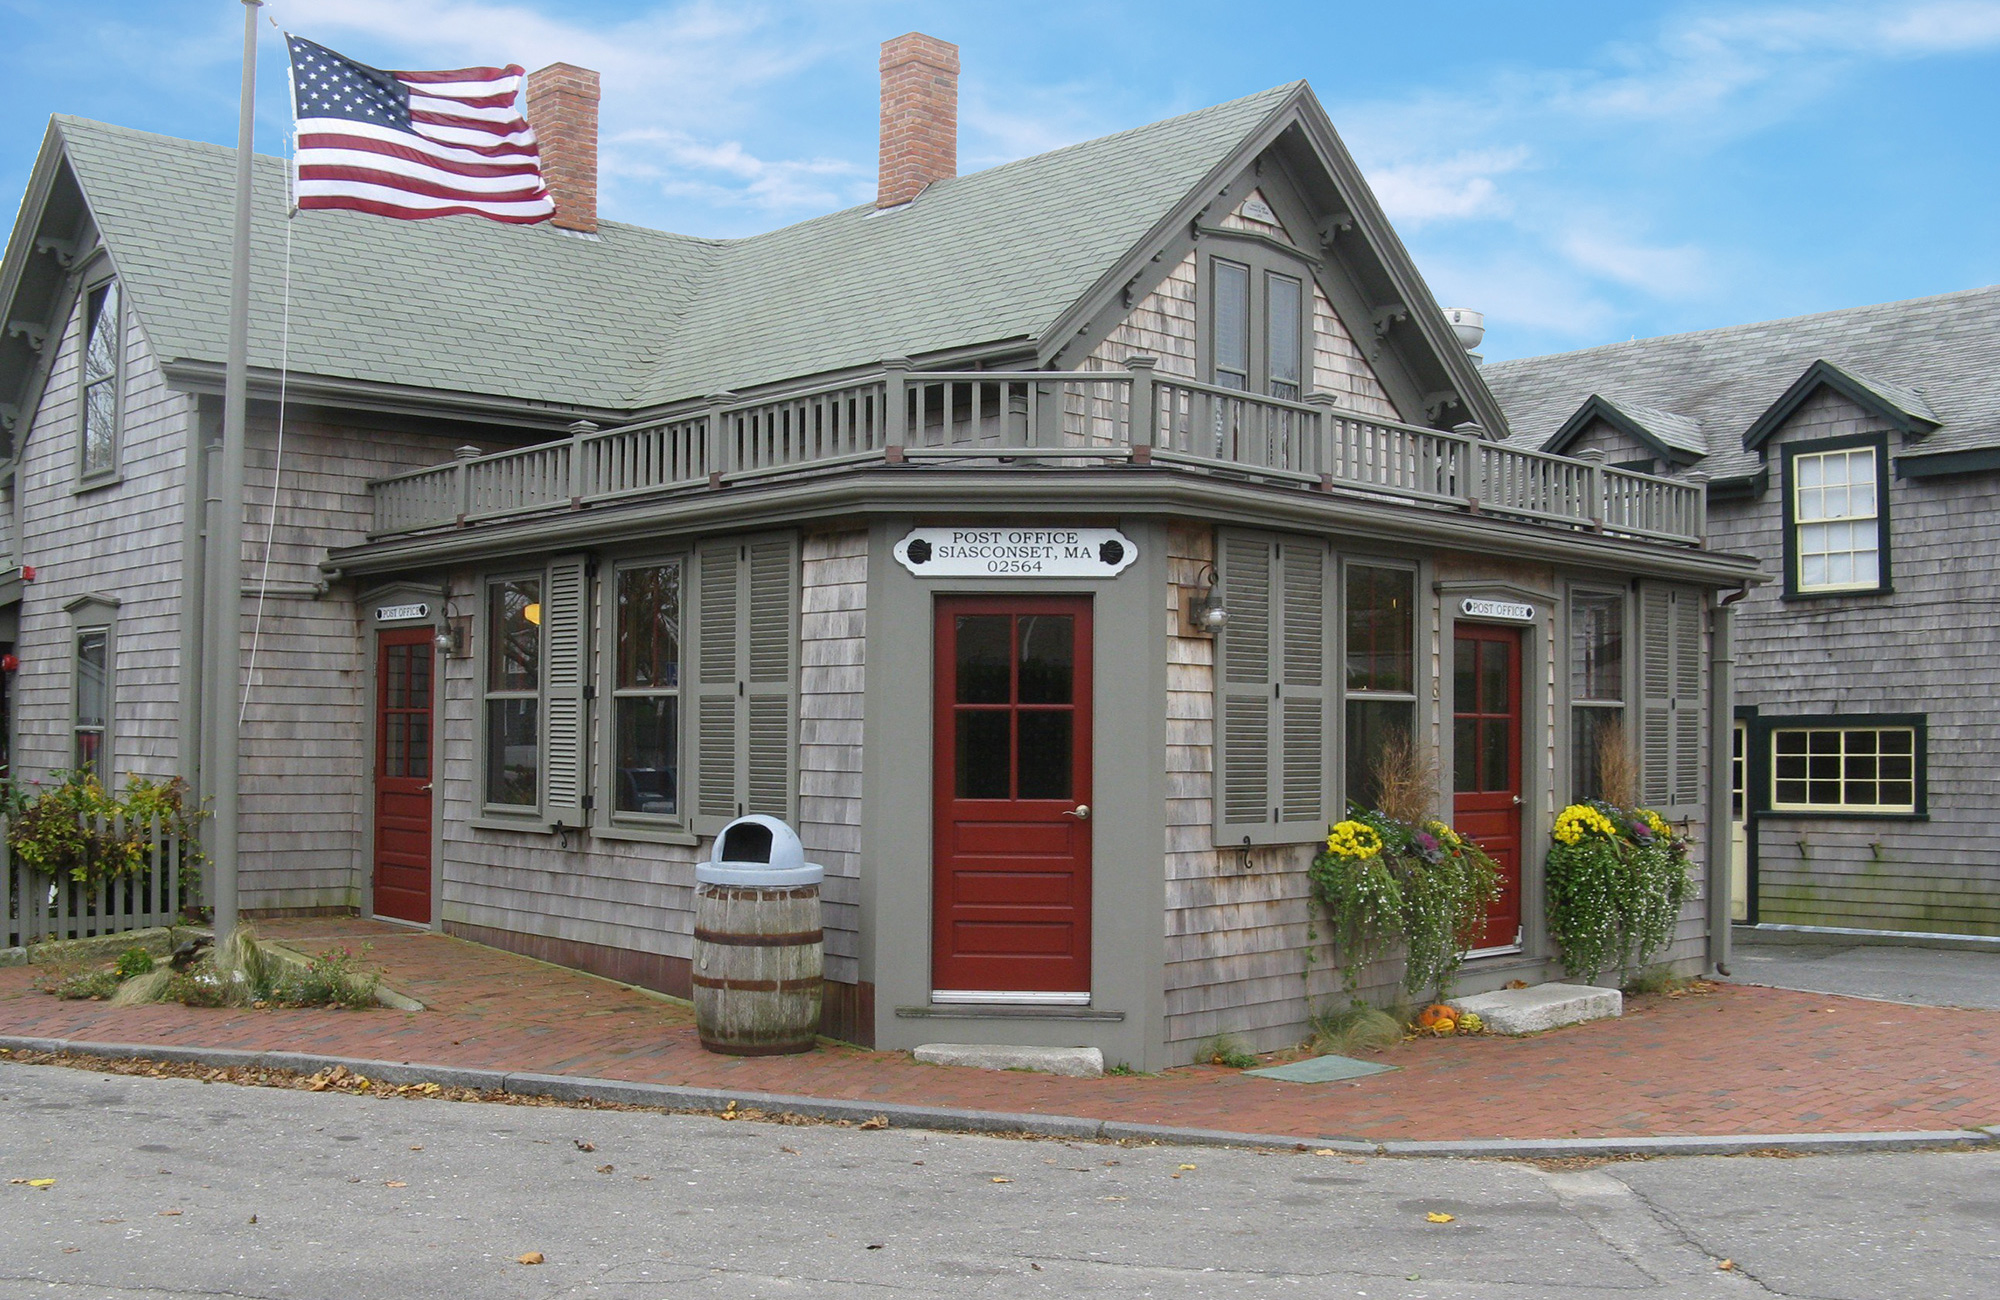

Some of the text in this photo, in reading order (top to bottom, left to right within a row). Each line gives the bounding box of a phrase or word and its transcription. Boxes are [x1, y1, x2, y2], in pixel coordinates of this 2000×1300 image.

[952, 531, 1079, 544] POST OFFICE
[938, 546, 1093, 561] SIASCONSET, MA
[987, 560, 1043, 573] 02564
[383, 606, 420, 618] POST OFFICE
[1473, 602, 1525, 617] POST OFFICE
